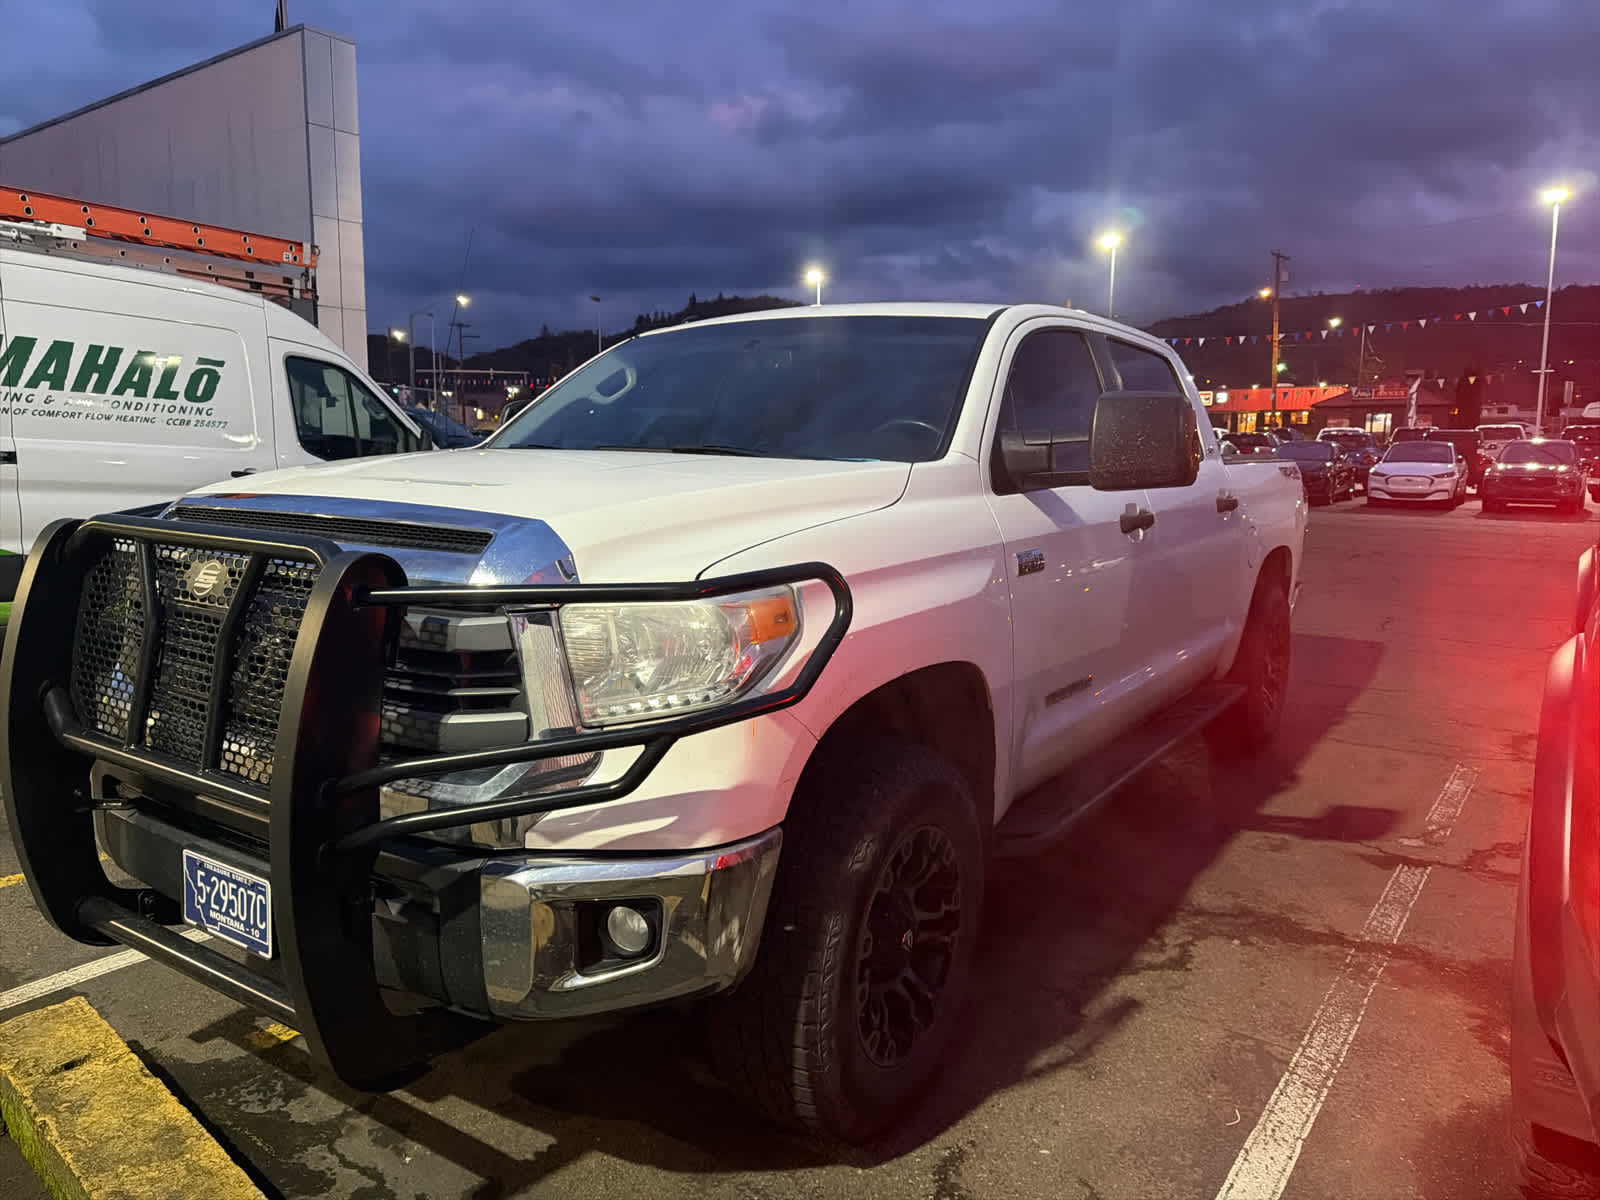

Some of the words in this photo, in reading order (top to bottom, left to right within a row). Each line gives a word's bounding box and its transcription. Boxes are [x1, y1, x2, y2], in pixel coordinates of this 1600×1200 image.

[0, 391, 35, 404] ING
[44, 395, 55, 405] &
[104, 400, 214, 416] ONDITIONING
[13, 407, 29, 416] OF
[32, 409, 83, 419] COMFORT
[85, 412, 113, 421] FLOW
[116, 414, 156, 424] HEATING
[209, 909, 245, 932] MONTANA
